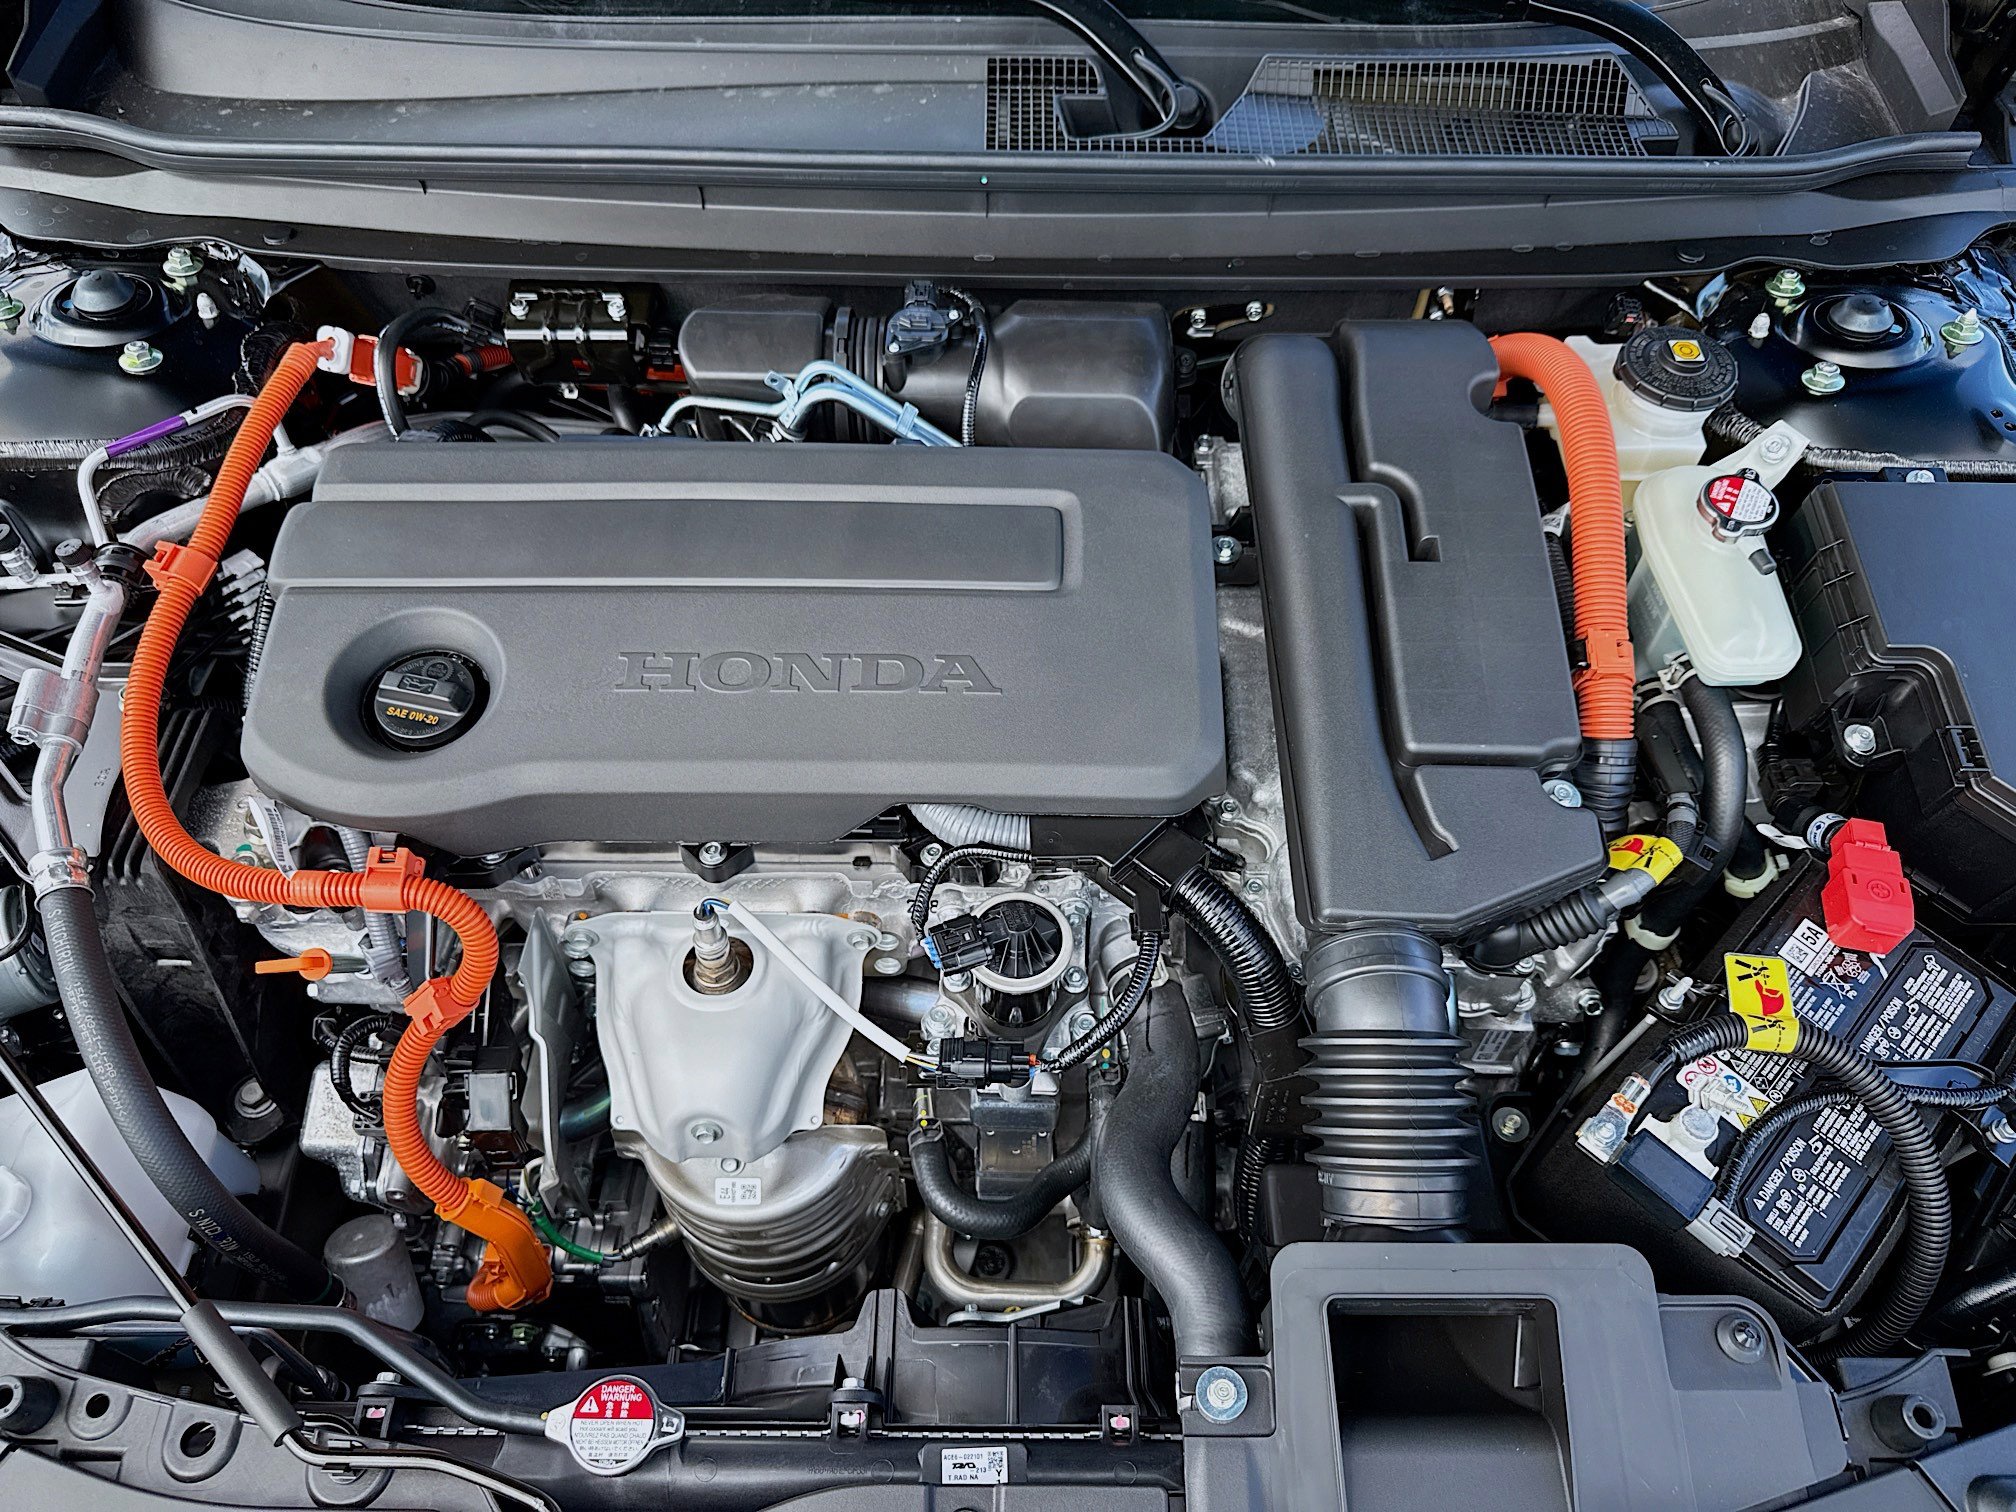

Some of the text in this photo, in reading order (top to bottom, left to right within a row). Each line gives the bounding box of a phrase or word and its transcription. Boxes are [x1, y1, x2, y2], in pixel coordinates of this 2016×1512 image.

[614, 651, 1002, 695] HONDA
[387, 706, 439, 725] SAE 0W-20
[1801, 926, 1824, 946] 5A
[601, 1385, 636, 1393] DANGER
[601, 1393, 643, 1402] WARNUNG
